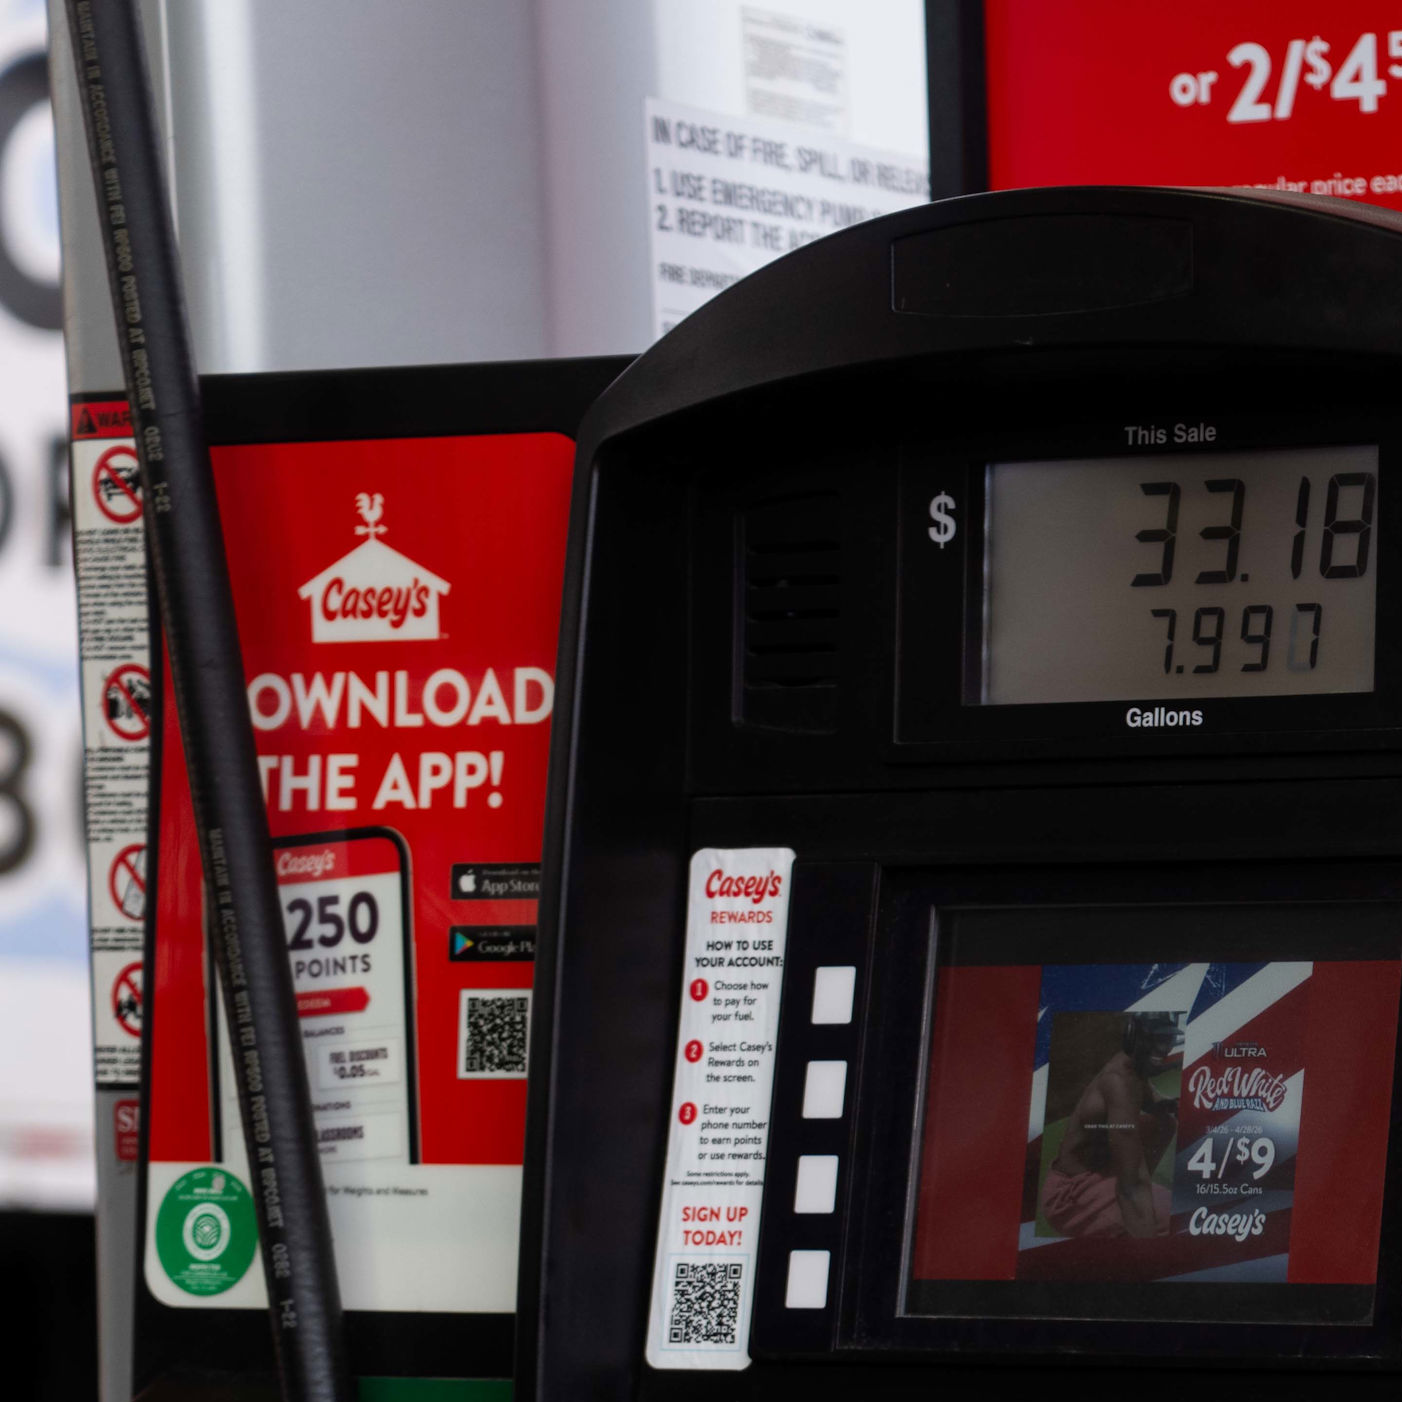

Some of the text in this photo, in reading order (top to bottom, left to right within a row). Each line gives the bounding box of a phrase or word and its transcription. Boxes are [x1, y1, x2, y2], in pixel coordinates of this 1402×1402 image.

[1170, 66, 1217, 106] or
[651, 115, 671, 145] IN
[676, 120, 719, 151] CASE
[726, 131, 747, 159] OF
[672, 171, 705, 201] USE
[712, 179, 814, 221] EMERGENCY
[1312, 173, 1365, 199] price
[678, 206, 745, 243] REPORT
[752, 221, 784, 251] THE
[1124, 424, 1217, 446] This Sale
[928, 471, 1376, 587] $ 33.18
[321, 578, 429, 630] Casey's
[248, 668, 554, 732] OWNLOAD
[1125, 705, 1204, 729] Gallons
[374, 751, 504, 809] APP!
[278, 850, 334, 876] Casey's
[481, 880, 507, 894] App
[705, 869, 782, 904] Casey's
[710, 911, 773, 923] REWARDS
[478, 941, 518, 955] Google
[707, 940, 773, 950] HOW TO USE
[295, 954, 371, 979] POINTS
[695, 957, 783, 967] YOUR ACCOUNT:
[714, 981, 768, 990] Choose how
[1225, 1048, 1267, 1057] ULTRA
[1188, 1066, 1287, 1111] Red White
[1188, 1136, 1275, 1180] 4/$9
[1196, 1184, 1262, 1194] 16/15.5oz Cans
[682, 1207, 748, 1222] SIGN UP
[1189, 1206, 1266, 1242] Casey's
[683, 1230, 742, 1246] TODAY!
